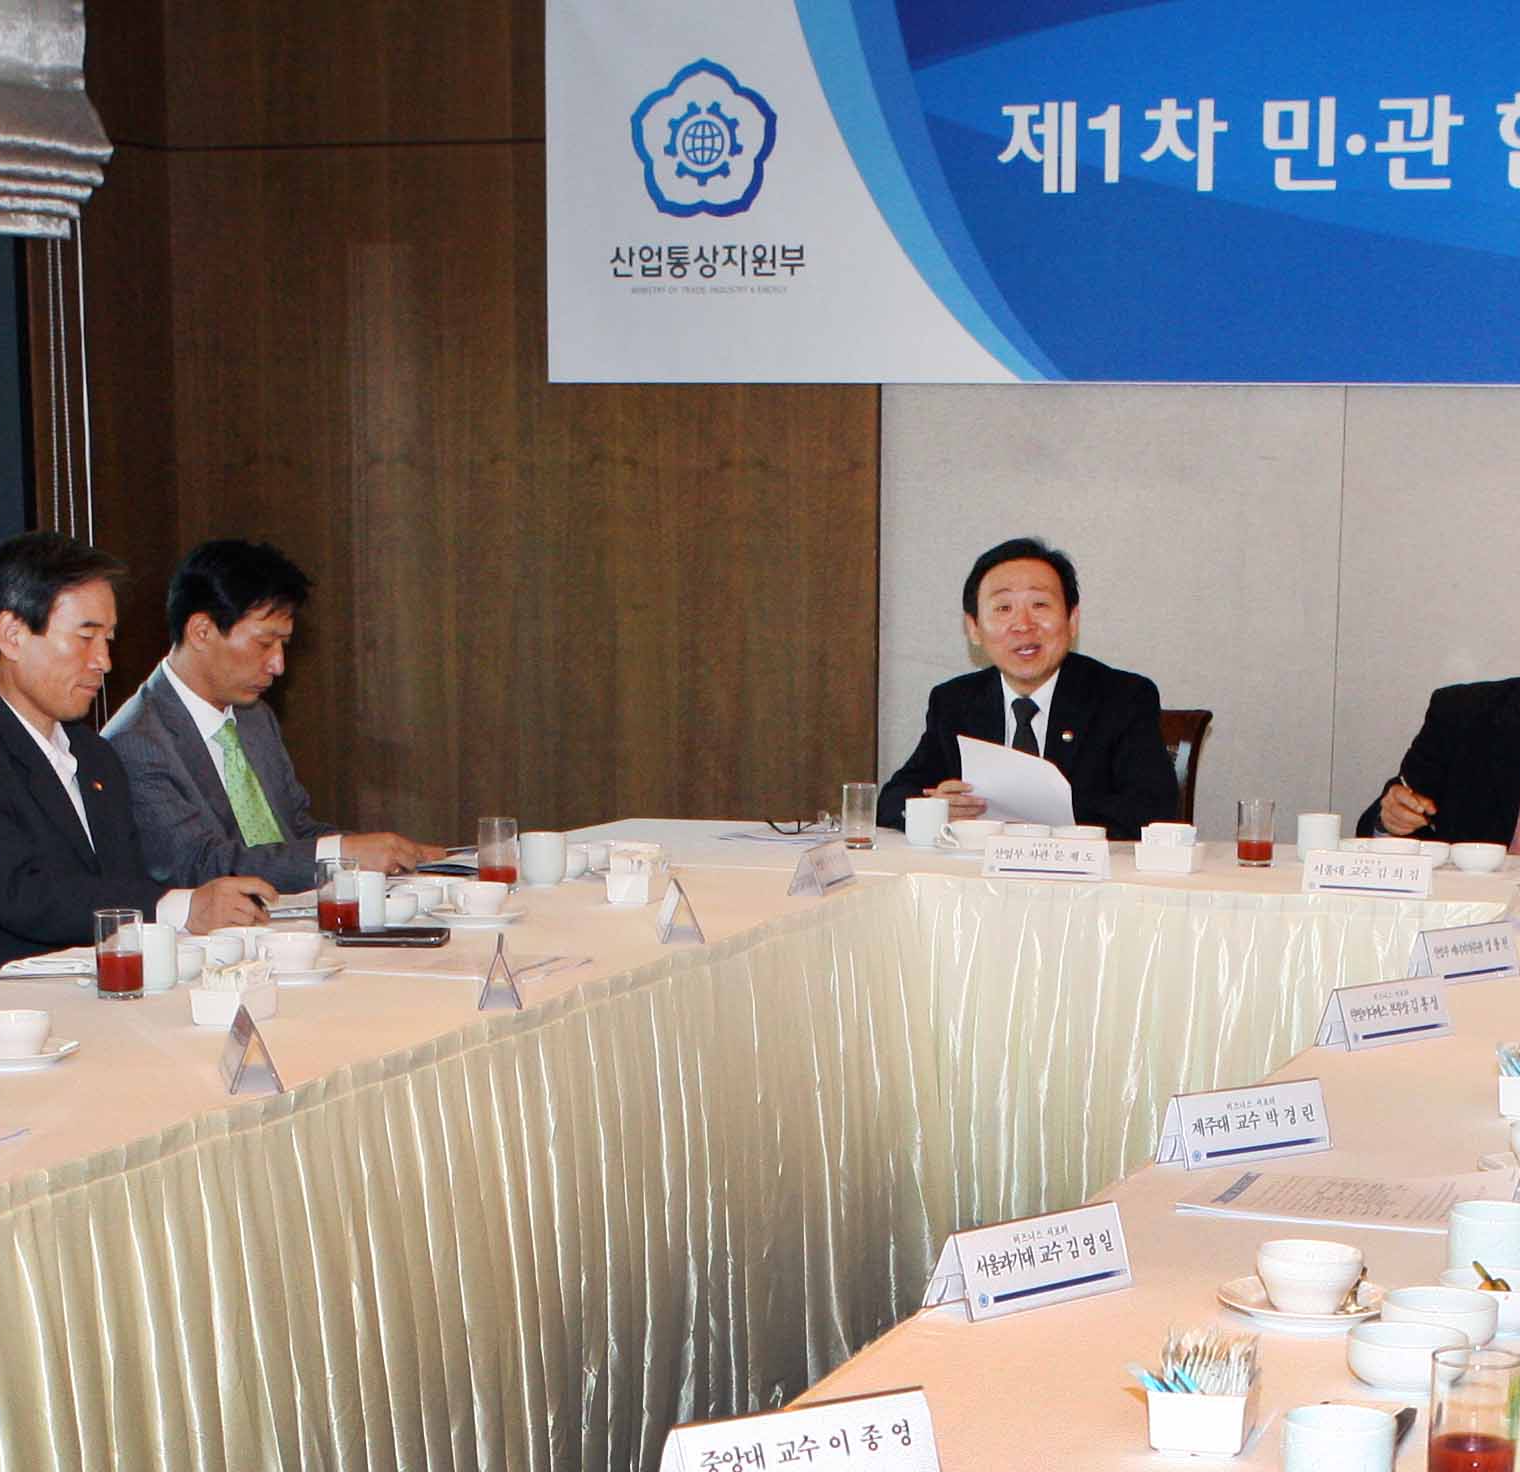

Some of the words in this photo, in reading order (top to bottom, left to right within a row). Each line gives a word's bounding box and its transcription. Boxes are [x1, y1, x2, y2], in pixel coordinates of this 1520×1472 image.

[997, 97, 1229, 195] 제1차
[609, 244, 806, 279] 산업통상자원부
[1191, 1113, 1231, 1137] 제주대
[1235, 1110, 1262, 1131] 교수
[975, 1244, 1036, 1279] 서울과기대
[1039, 1240, 1064, 1265] 교수
[775, 1434, 821, 1466] 교수
